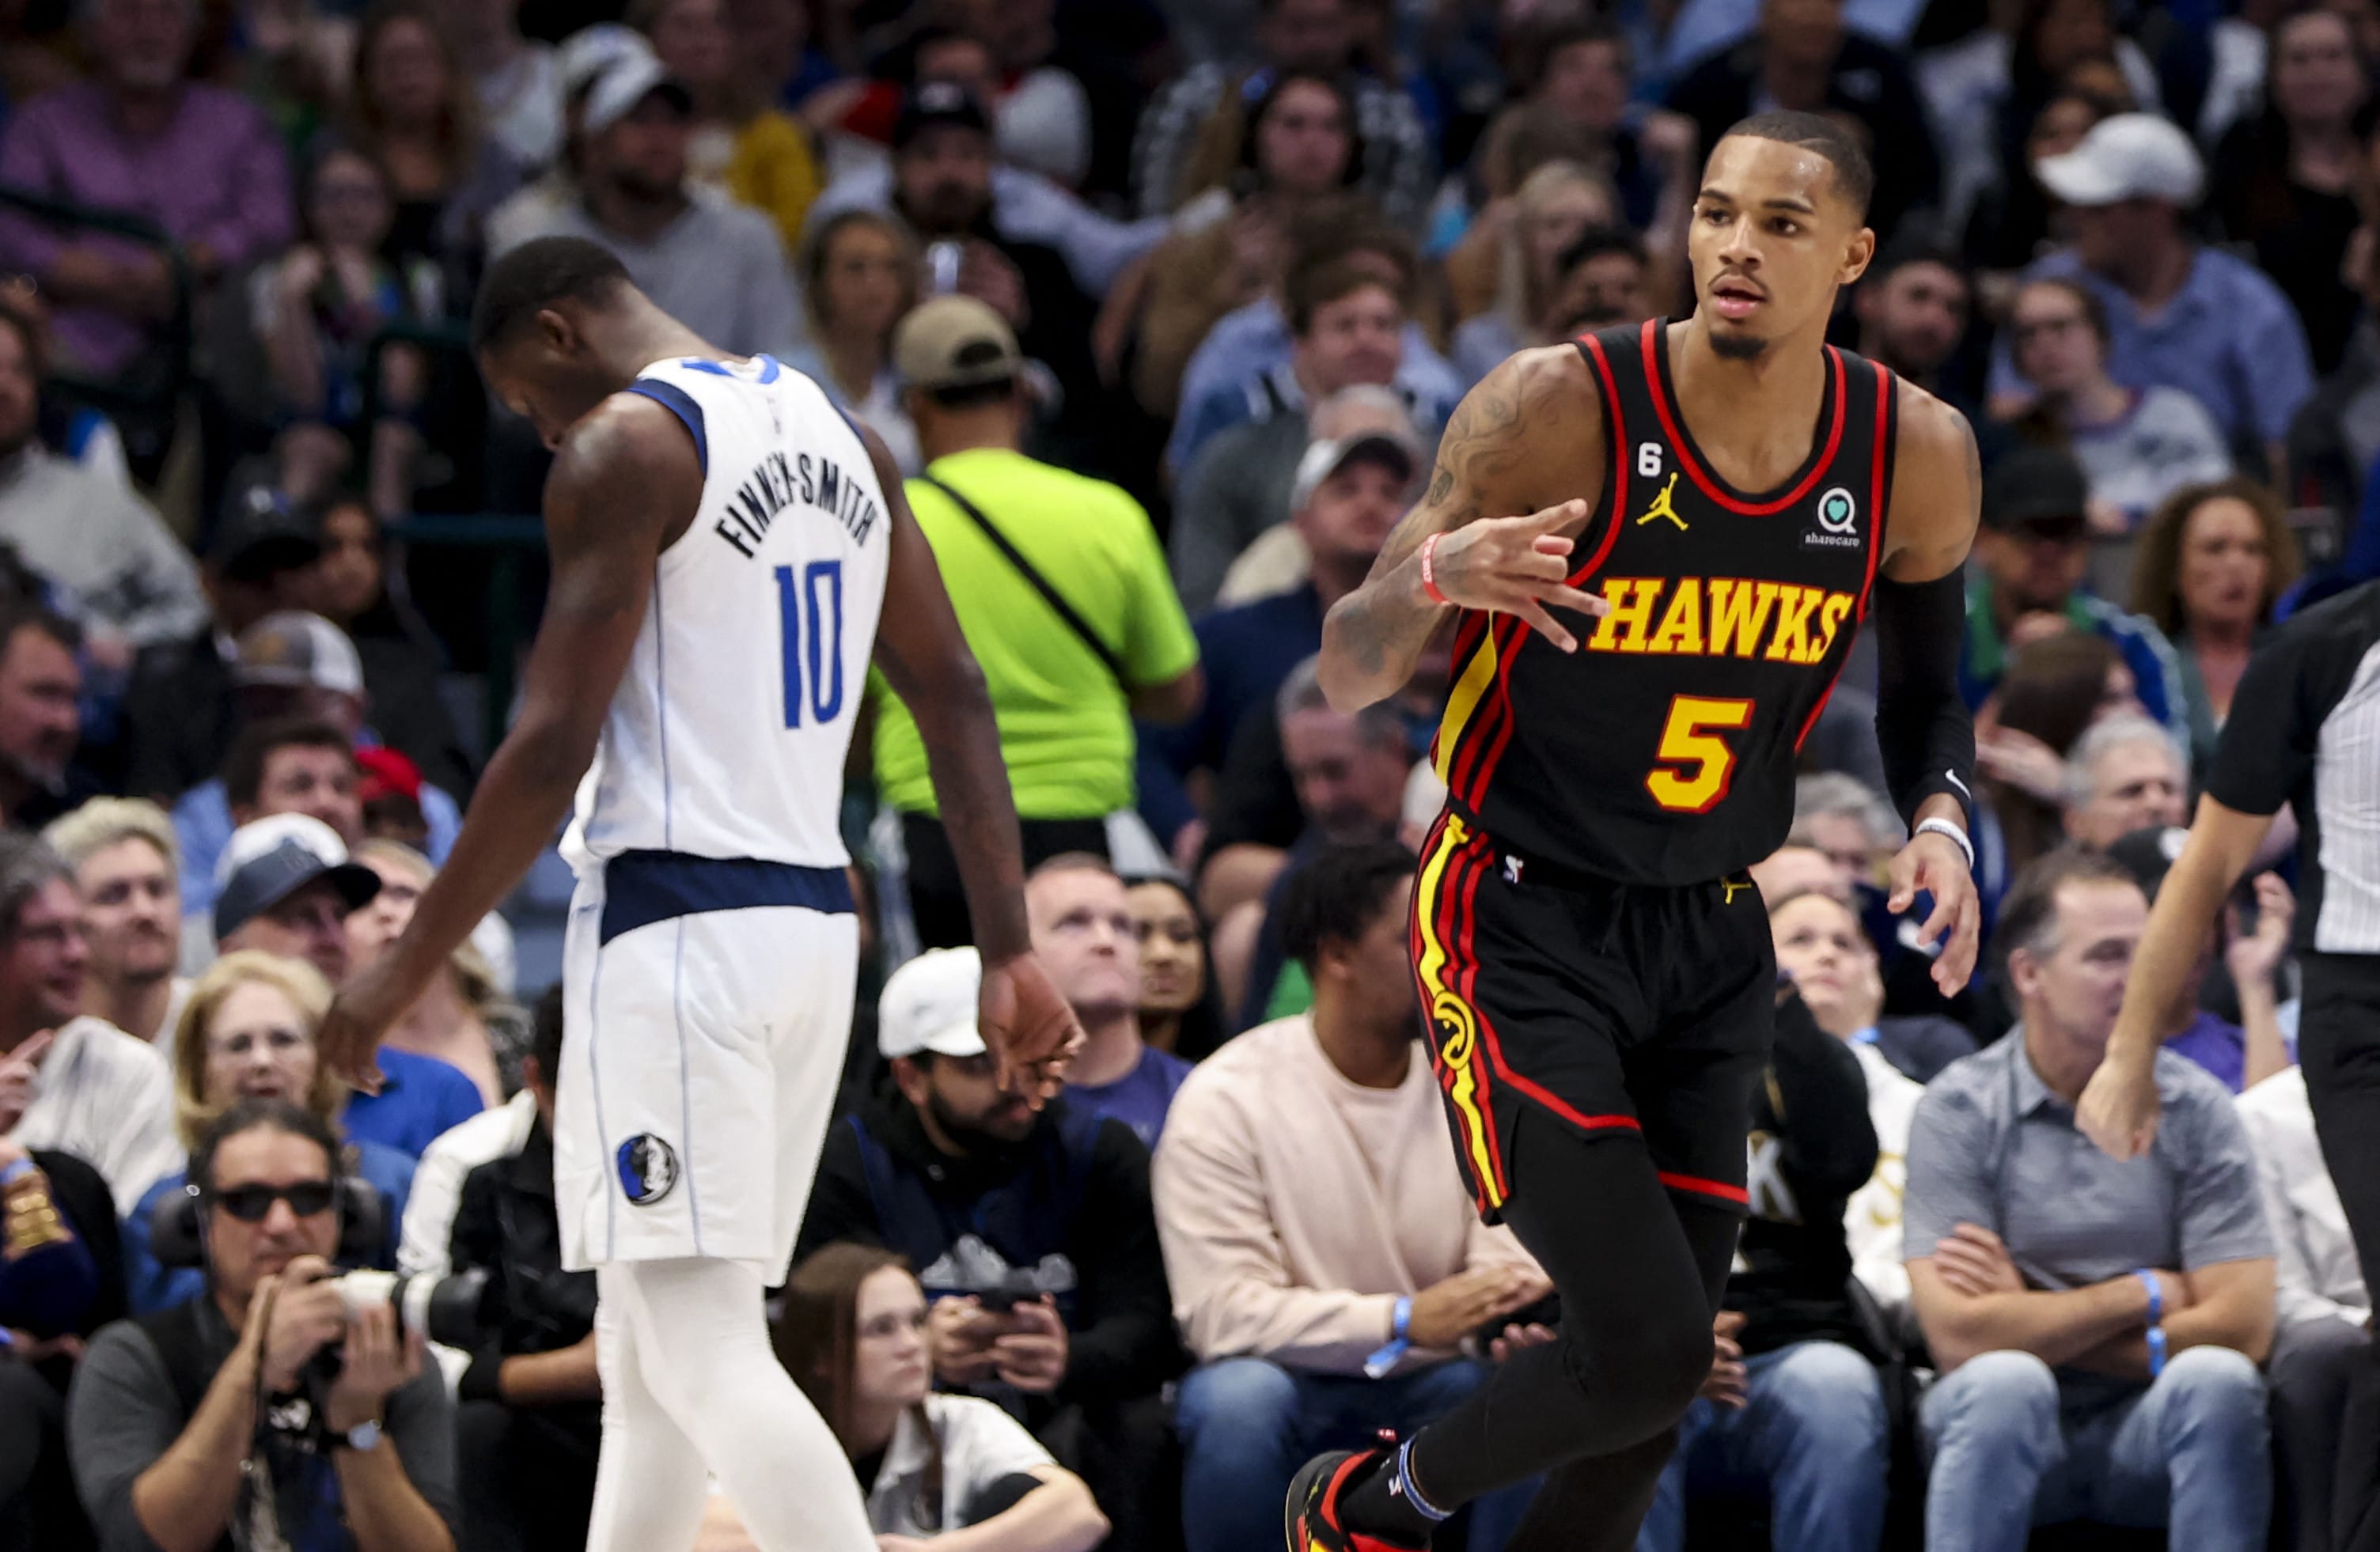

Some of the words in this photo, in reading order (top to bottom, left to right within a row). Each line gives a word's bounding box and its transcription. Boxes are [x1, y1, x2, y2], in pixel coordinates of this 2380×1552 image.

[714, 451, 878, 558] FINNEY-SMITH
[1638, 441, 1662, 477] 6
[1805, 531, 1860, 547] sharecare
[774, 559, 843, 730] 10
[1586, 576, 1856, 666] HAWKS
[1643, 694, 1756, 815] 5
